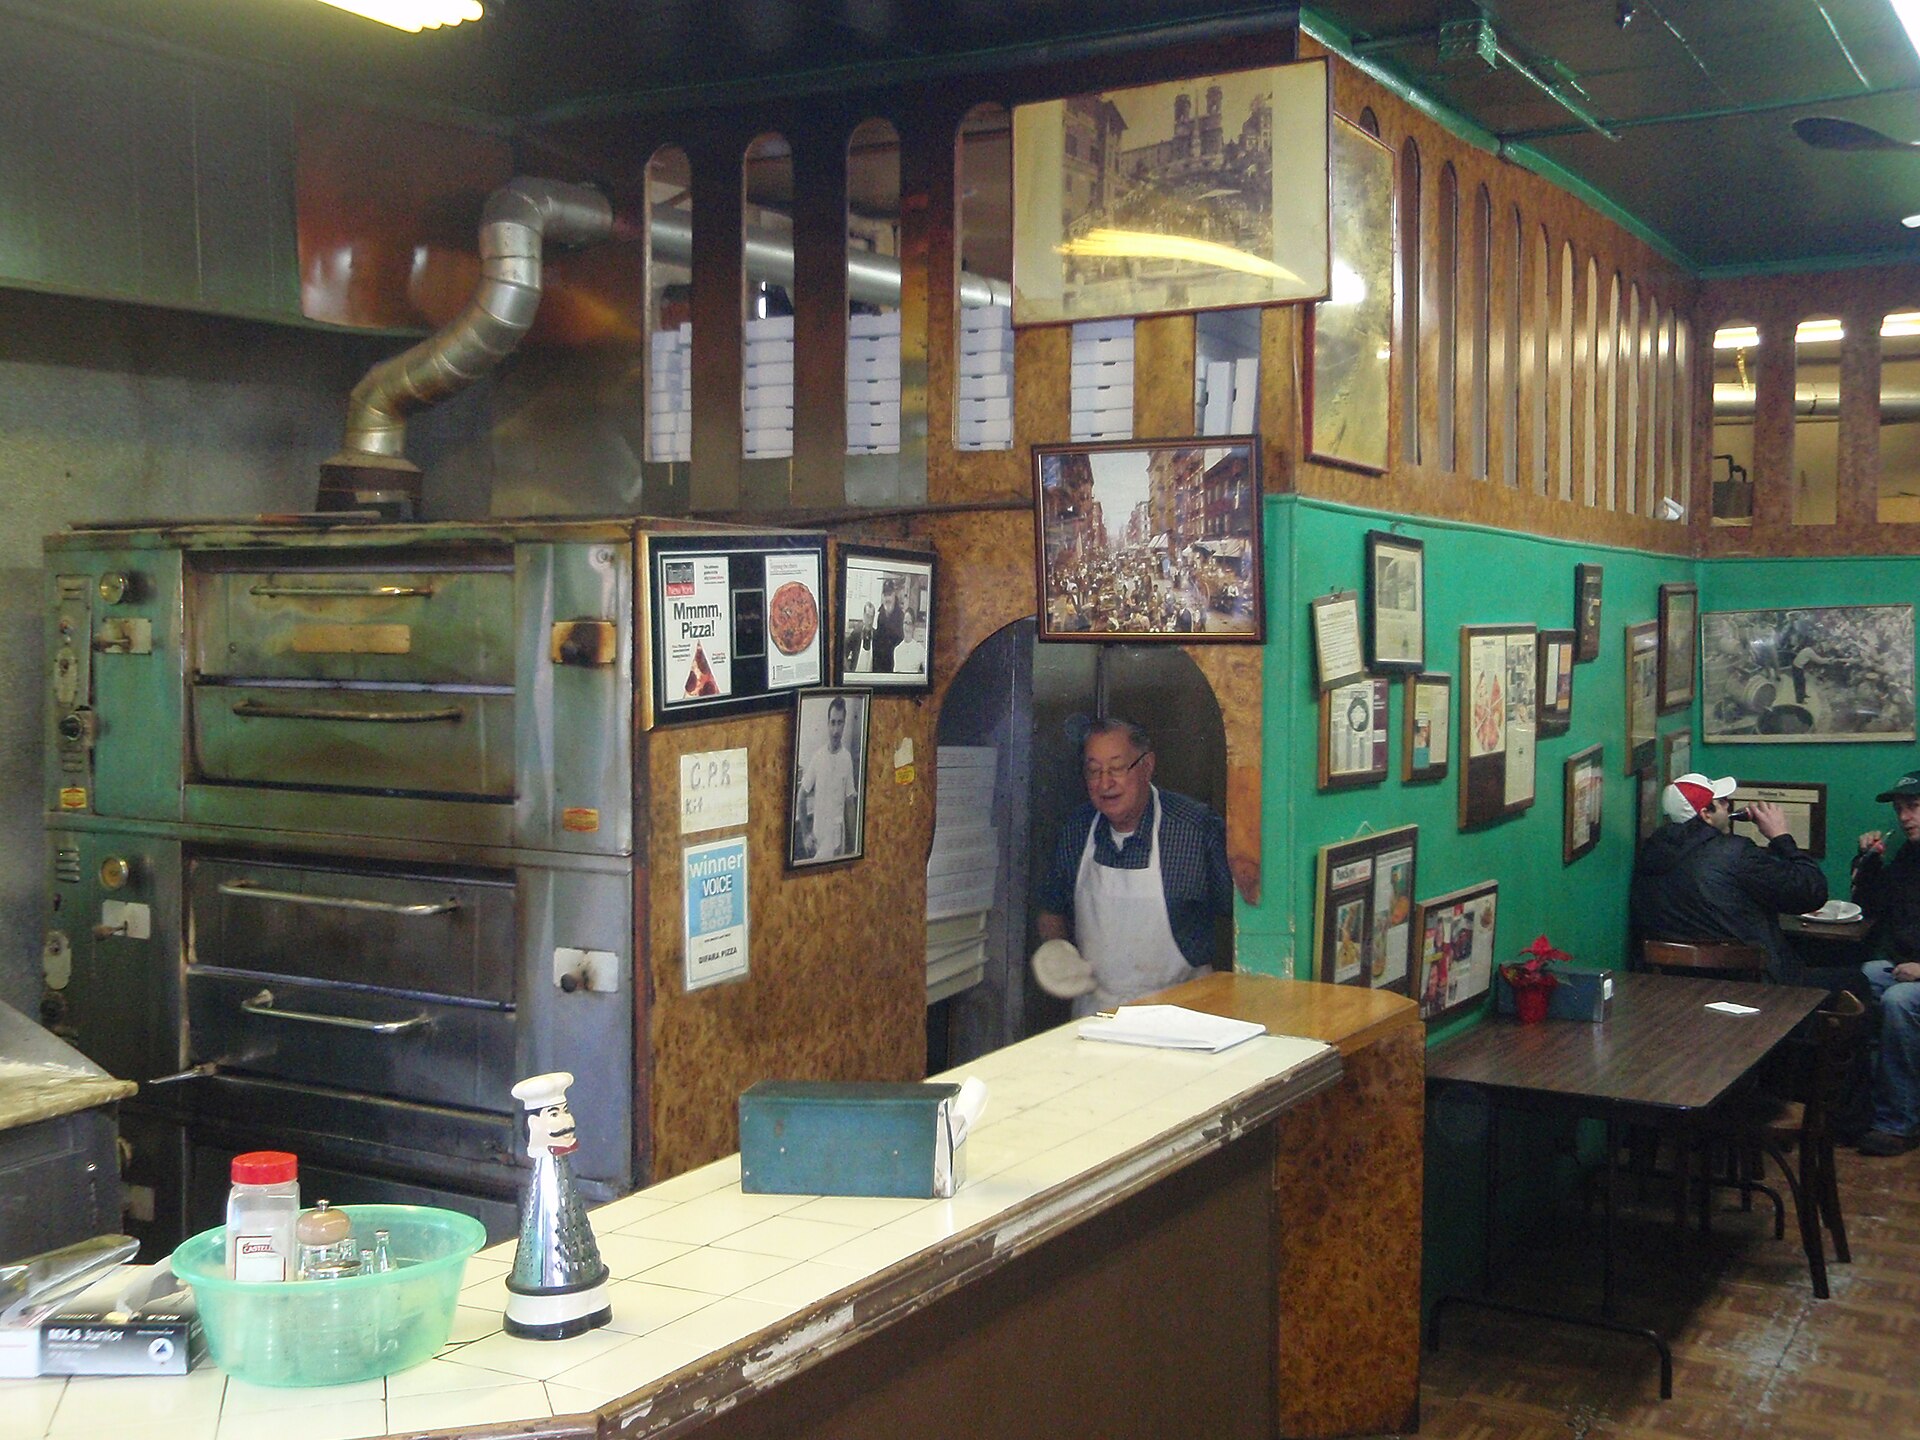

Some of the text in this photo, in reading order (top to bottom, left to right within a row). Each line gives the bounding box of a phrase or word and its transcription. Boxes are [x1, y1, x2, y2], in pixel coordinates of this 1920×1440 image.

[673, 602, 722, 620] Mmmm,
[681, 619, 715, 640] Pizza!
[685, 796, 704, 815] Kit
[689, 853, 743, 878] winner
[702, 874, 733, 897] VOICE
[720, 946, 738, 958] PIZZA
